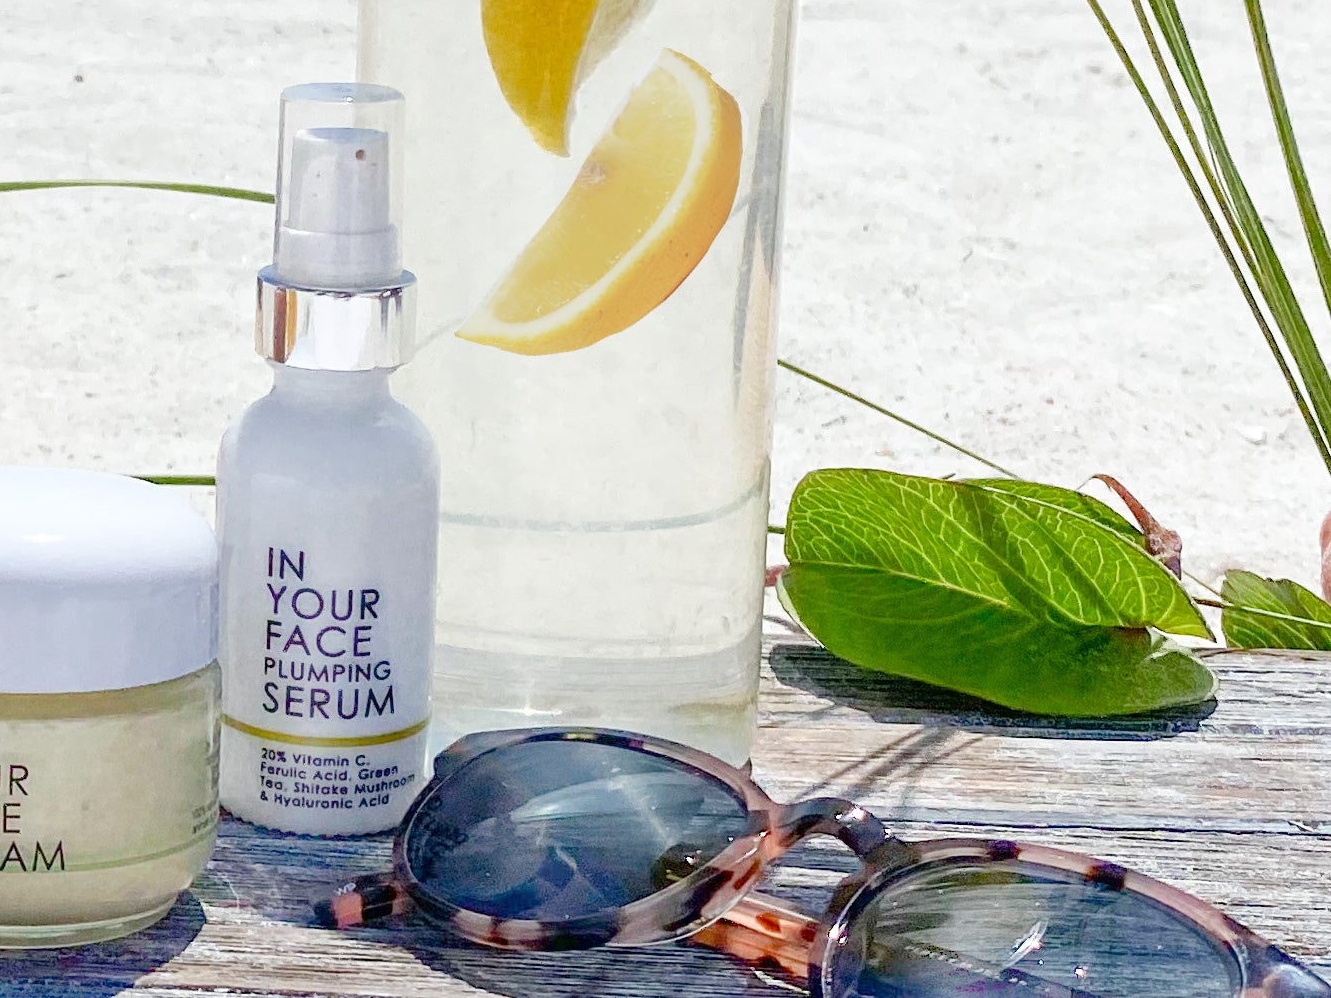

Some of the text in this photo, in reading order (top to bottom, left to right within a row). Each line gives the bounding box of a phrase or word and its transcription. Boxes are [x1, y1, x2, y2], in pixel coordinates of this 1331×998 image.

[268, 547, 304, 581] IN
[267, 583, 380, 621] YOUR
[266, 620, 372, 657] FACE
[264, 657, 391, 683] PLUMPING
[262, 682, 395, 719] SERUM
[261, 747, 287, 763] 20%
[292, 753, 349, 767] Vitamin
[260, 761, 306, 779] Ferulic
[358, 765, 398, 780] Green
[293, 782, 348, 795] Shitake
[354, 773, 415, 794] Mushroom
[260, 790, 389, 809] & Hyaluronic Acid
